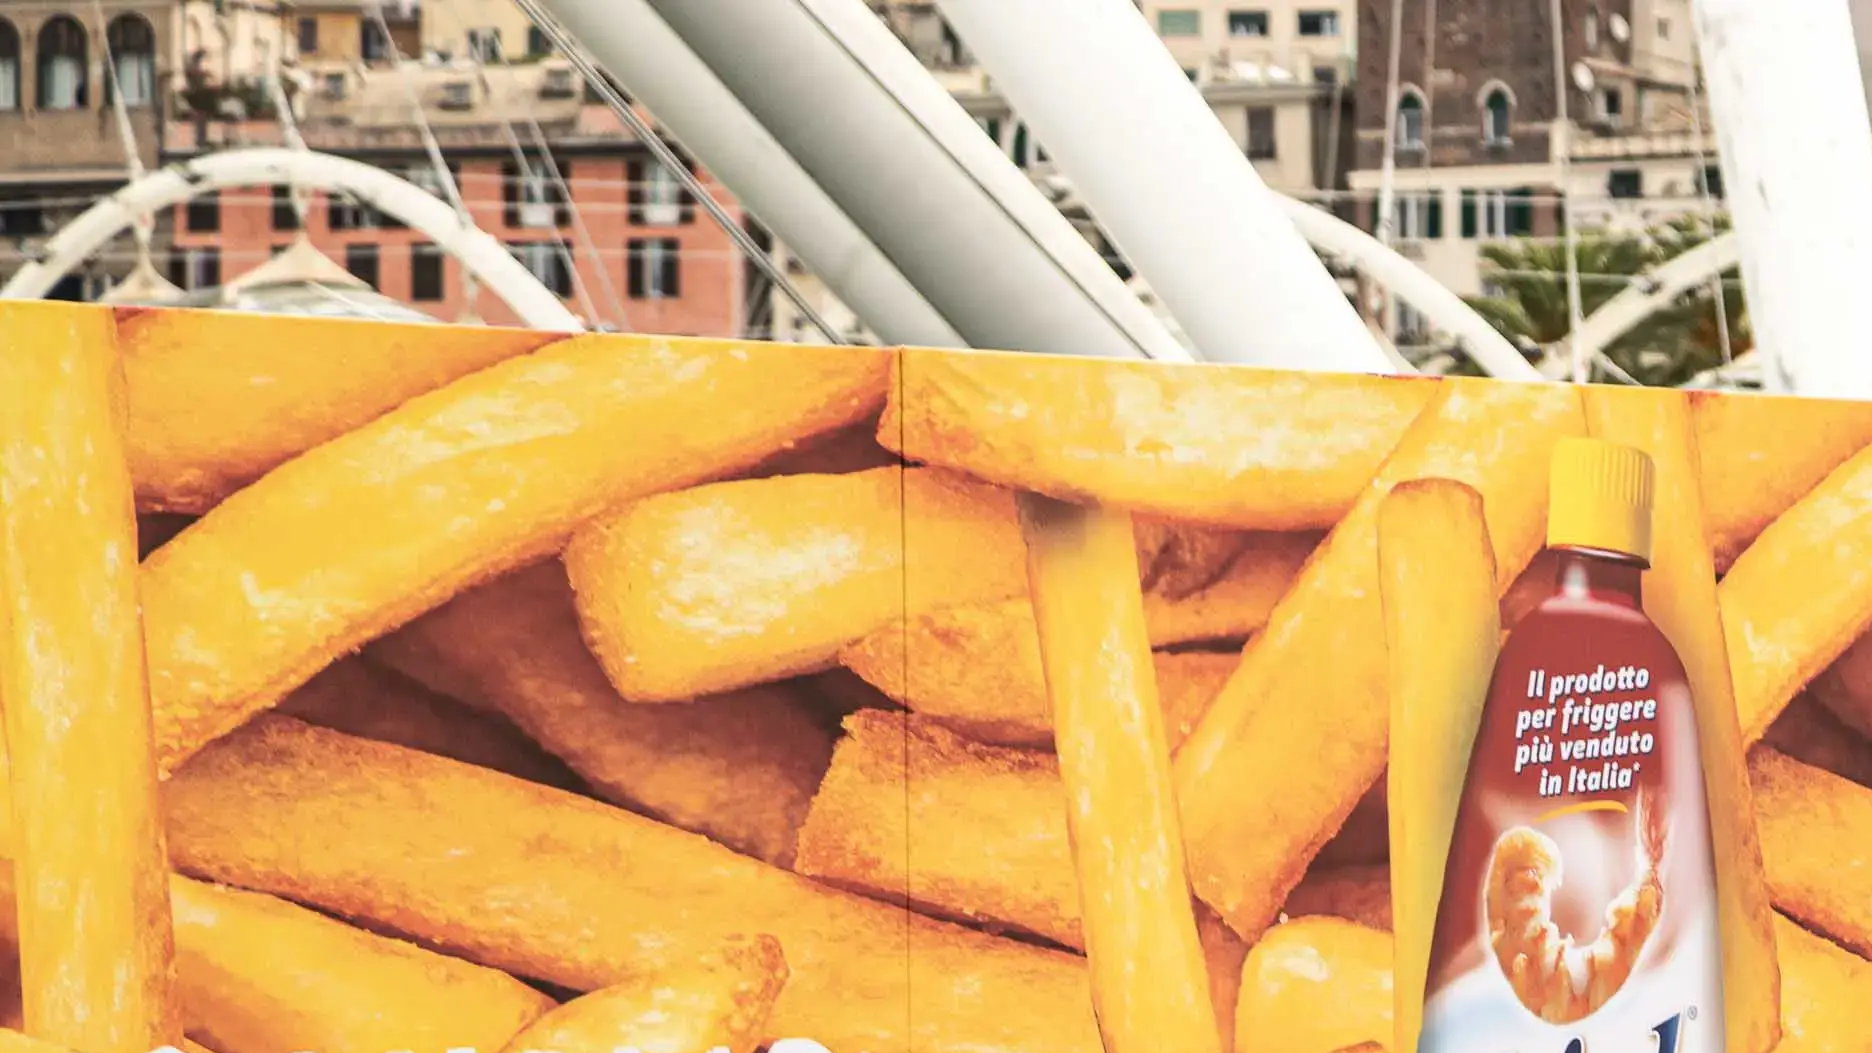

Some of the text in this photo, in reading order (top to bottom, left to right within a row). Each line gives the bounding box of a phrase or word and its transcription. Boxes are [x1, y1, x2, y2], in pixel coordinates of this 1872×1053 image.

[1527, 664, 1650, 704] Il prodotto
[1515, 697, 1657, 739] per friggere
[1514, 730, 1655, 774] più venduto
[1539, 768, 1563, 797] in
